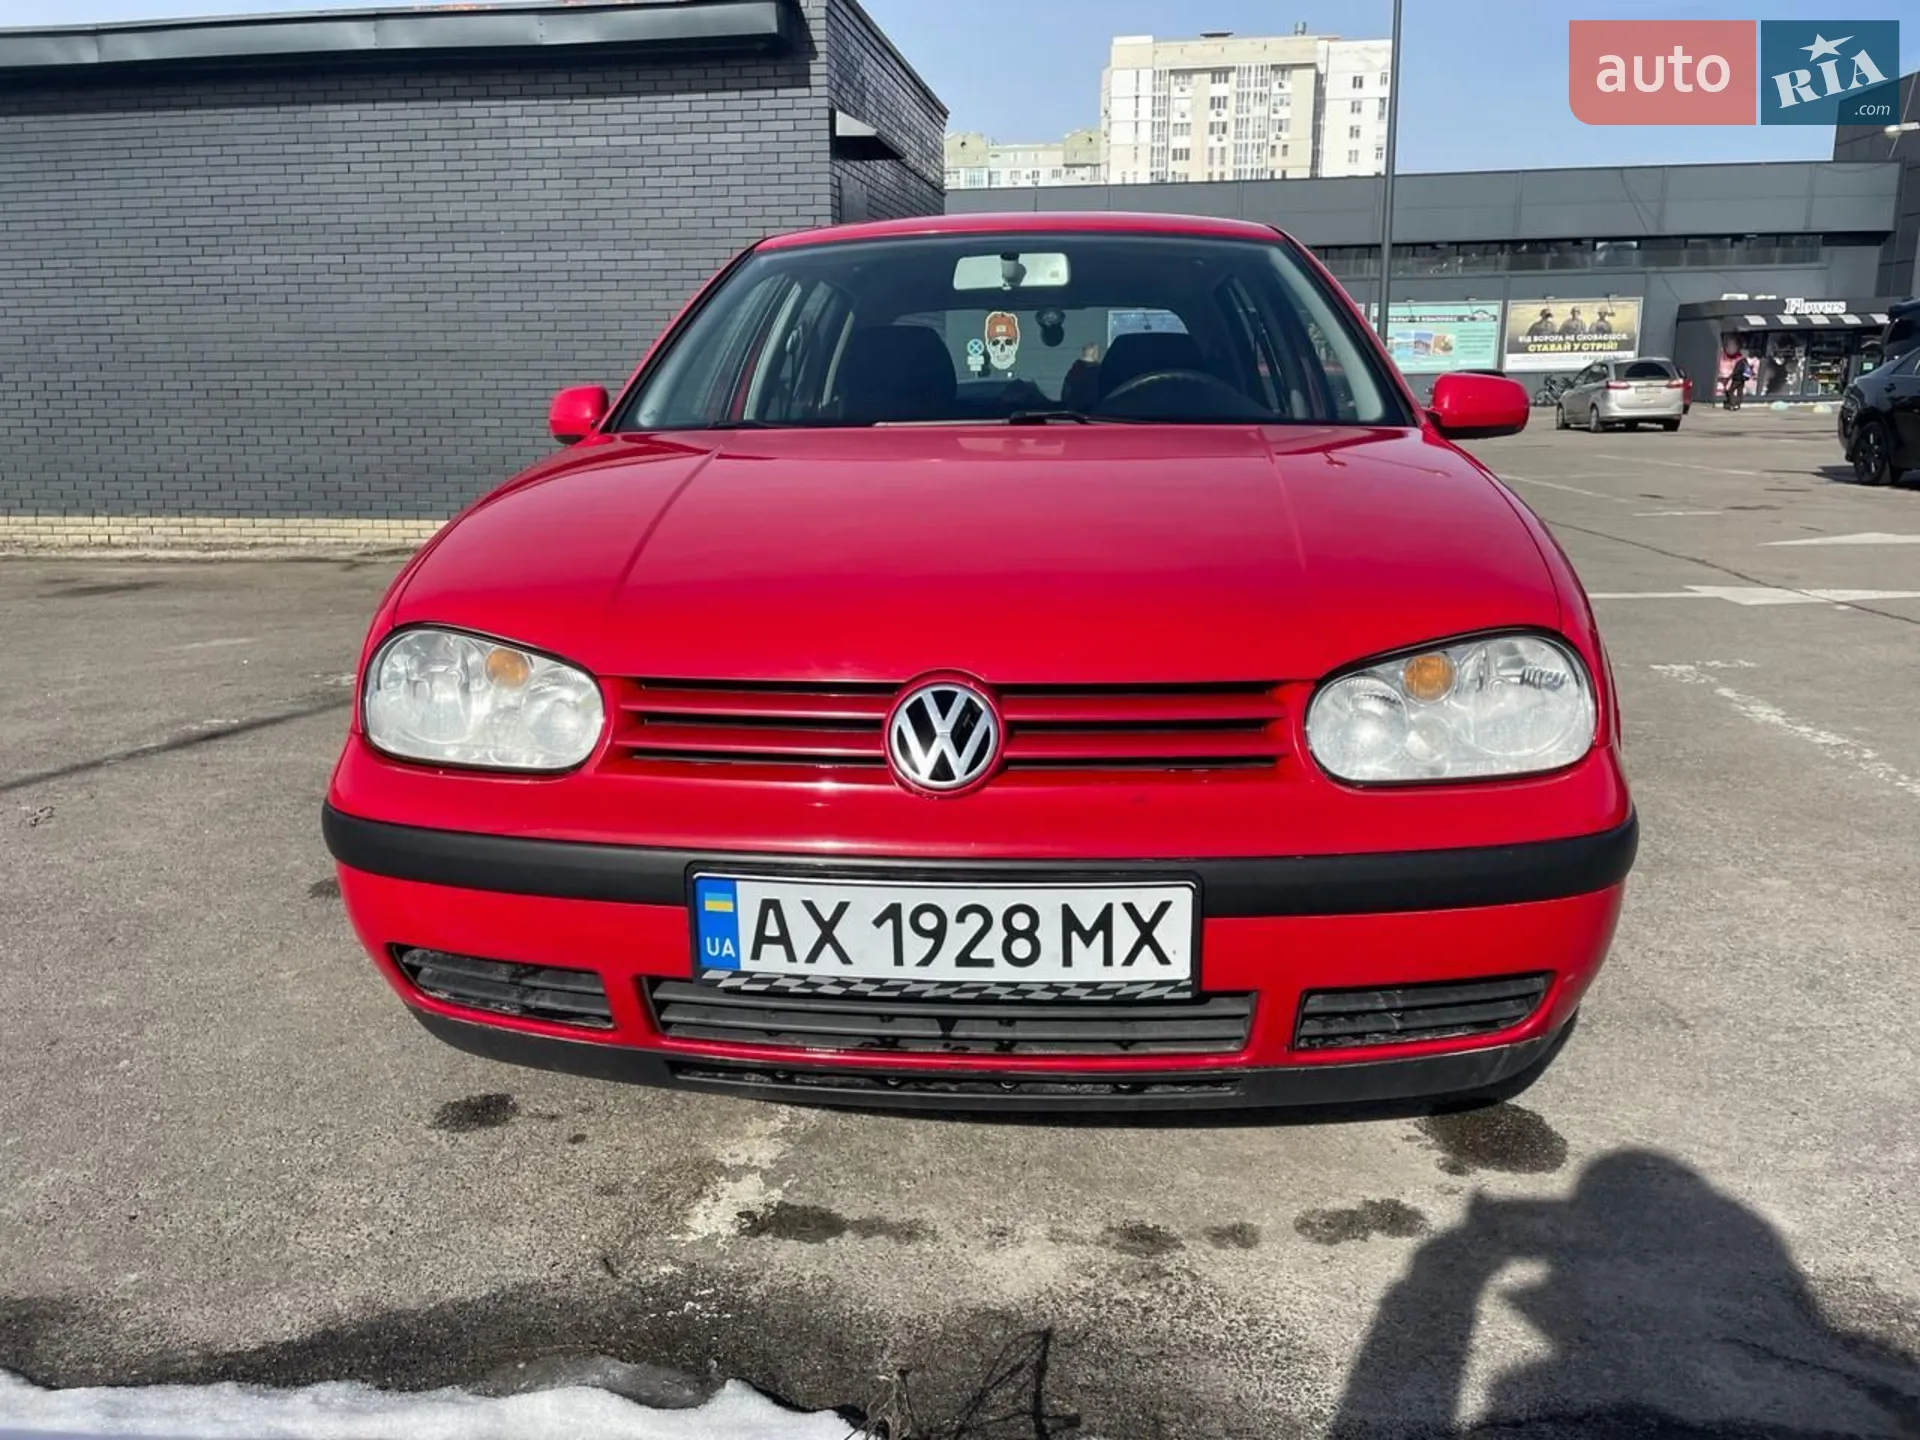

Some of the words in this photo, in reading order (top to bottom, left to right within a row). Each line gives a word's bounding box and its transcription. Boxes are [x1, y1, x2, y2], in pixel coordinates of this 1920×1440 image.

[1783, 298, 1846, 314] Flowers
[1528, 342, 1571, 352] СТАВАЙ
[1573, 343, 1580, 351] У
[1581, 341, 1618, 351] СТРІЙ!
[750, 898, 853, 965] AX
[871, 901, 1042, 968] 1928
[1061, 900, 1173, 968] MX
[706, 936, 736, 958] UA
